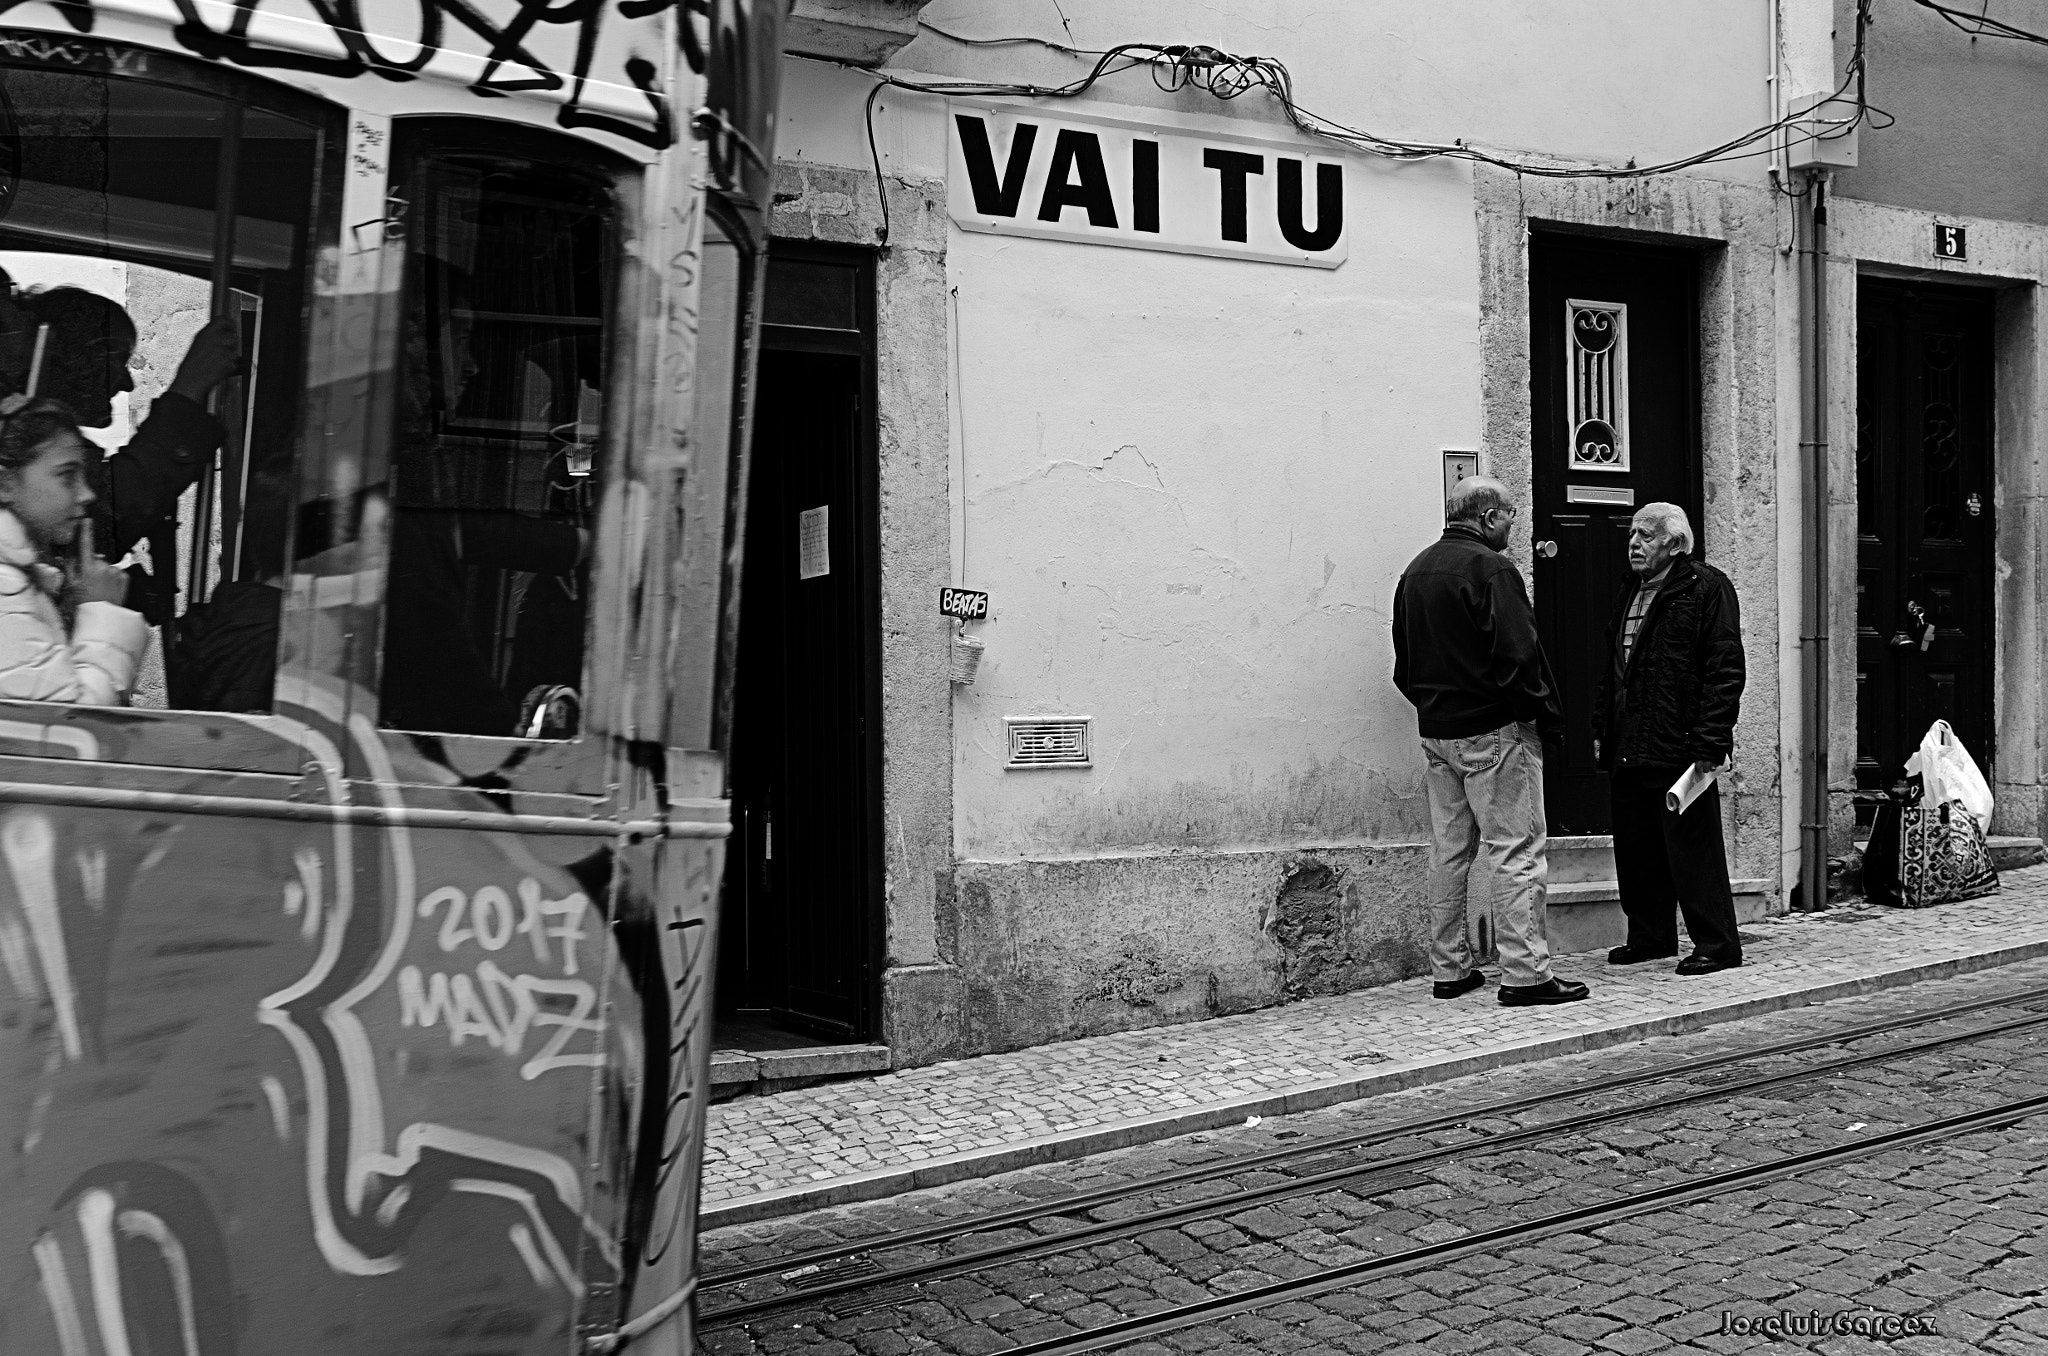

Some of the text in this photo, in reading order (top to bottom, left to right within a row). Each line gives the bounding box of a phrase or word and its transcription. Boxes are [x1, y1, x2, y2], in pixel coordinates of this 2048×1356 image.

[955, 114, 1343, 251] VAI TU
[1945, 227, 1957, 255] 5
[943, 589, 987, 616] BEATAS
[418, 877, 589, 975] 2017
